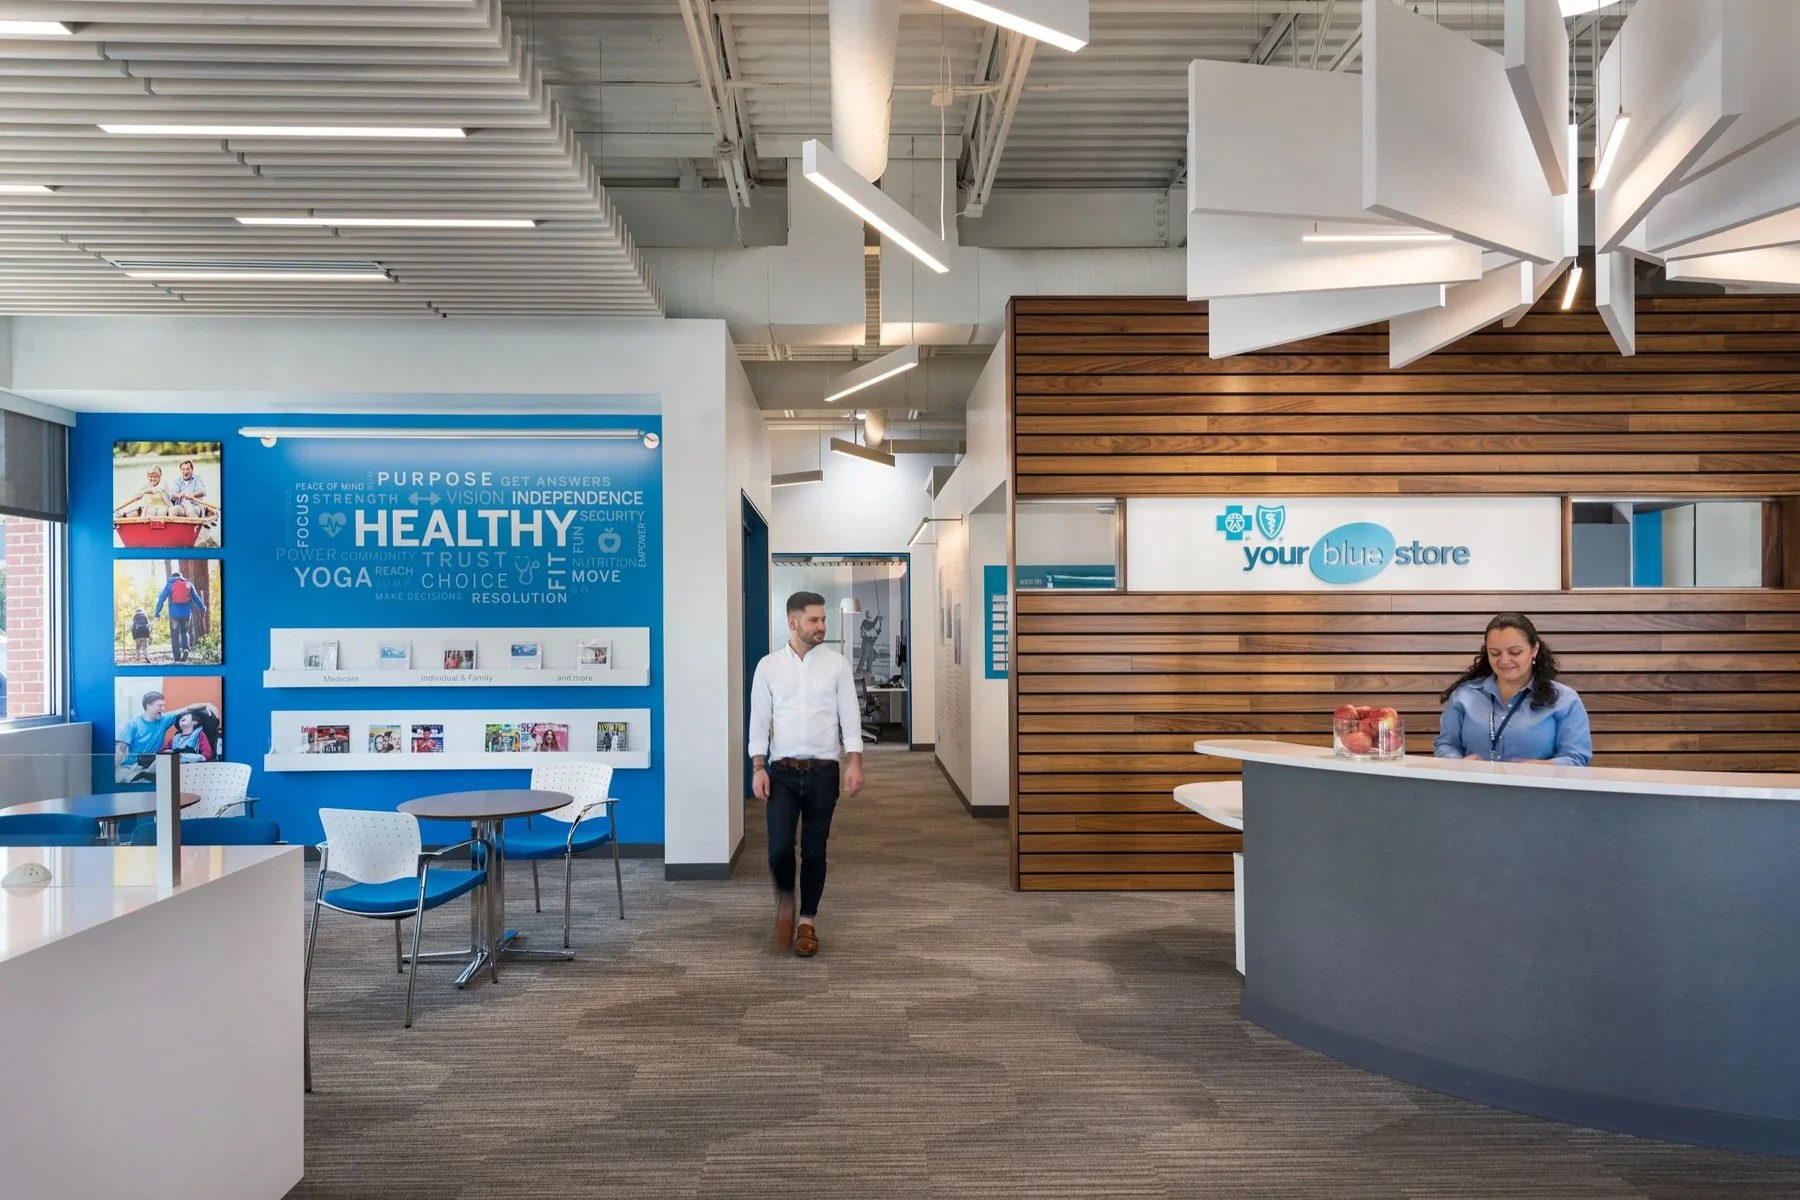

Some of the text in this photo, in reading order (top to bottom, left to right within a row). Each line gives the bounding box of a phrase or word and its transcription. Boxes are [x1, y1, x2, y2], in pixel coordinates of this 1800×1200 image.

[377, 471, 493, 486] PURPOSE
[500, 476, 611, 487] GET ANSWERS
[295, 482, 365, 491] PEACE OF MIND
[312, 493, 398, 505] STRENGTH
[446, 490, 504, 505] VISION
[511, 491, 644, 505] INDEPENDENCE
[296, 493, 309, 548] FOCUS
[579, 510, 645, 522] SECURITY
[354, 509, 578, 547] HEALTHY
[572, 526, 584, 554] FUN
[637, 522, 646, 568] EMPOWER
[276, 548, 337, 561] POWER
[340, 551, 416, 562] COMMUNITY
[421, 551, 507, 568] TRUST
[1242, 539, 1471, 571] your blue store
[572, 557, 637, 568] NUTRITION
[294, 567, 373, 588] YOGA
[375, 566, 414, 576] REACH
[547, 552, 566, 590] FIT
[571, 569, 621, 583] MOVE
[421, 573, 508, 589] CHOICE
[375, 592, 463, 601] MAKE DECISIONS
[471, 592, 567, 604] RESOLUTION
[323, 675, 360, 683] Medicare
[421, 674, 493, 683] Individual & Family
[556, 674, 572, 682] and
